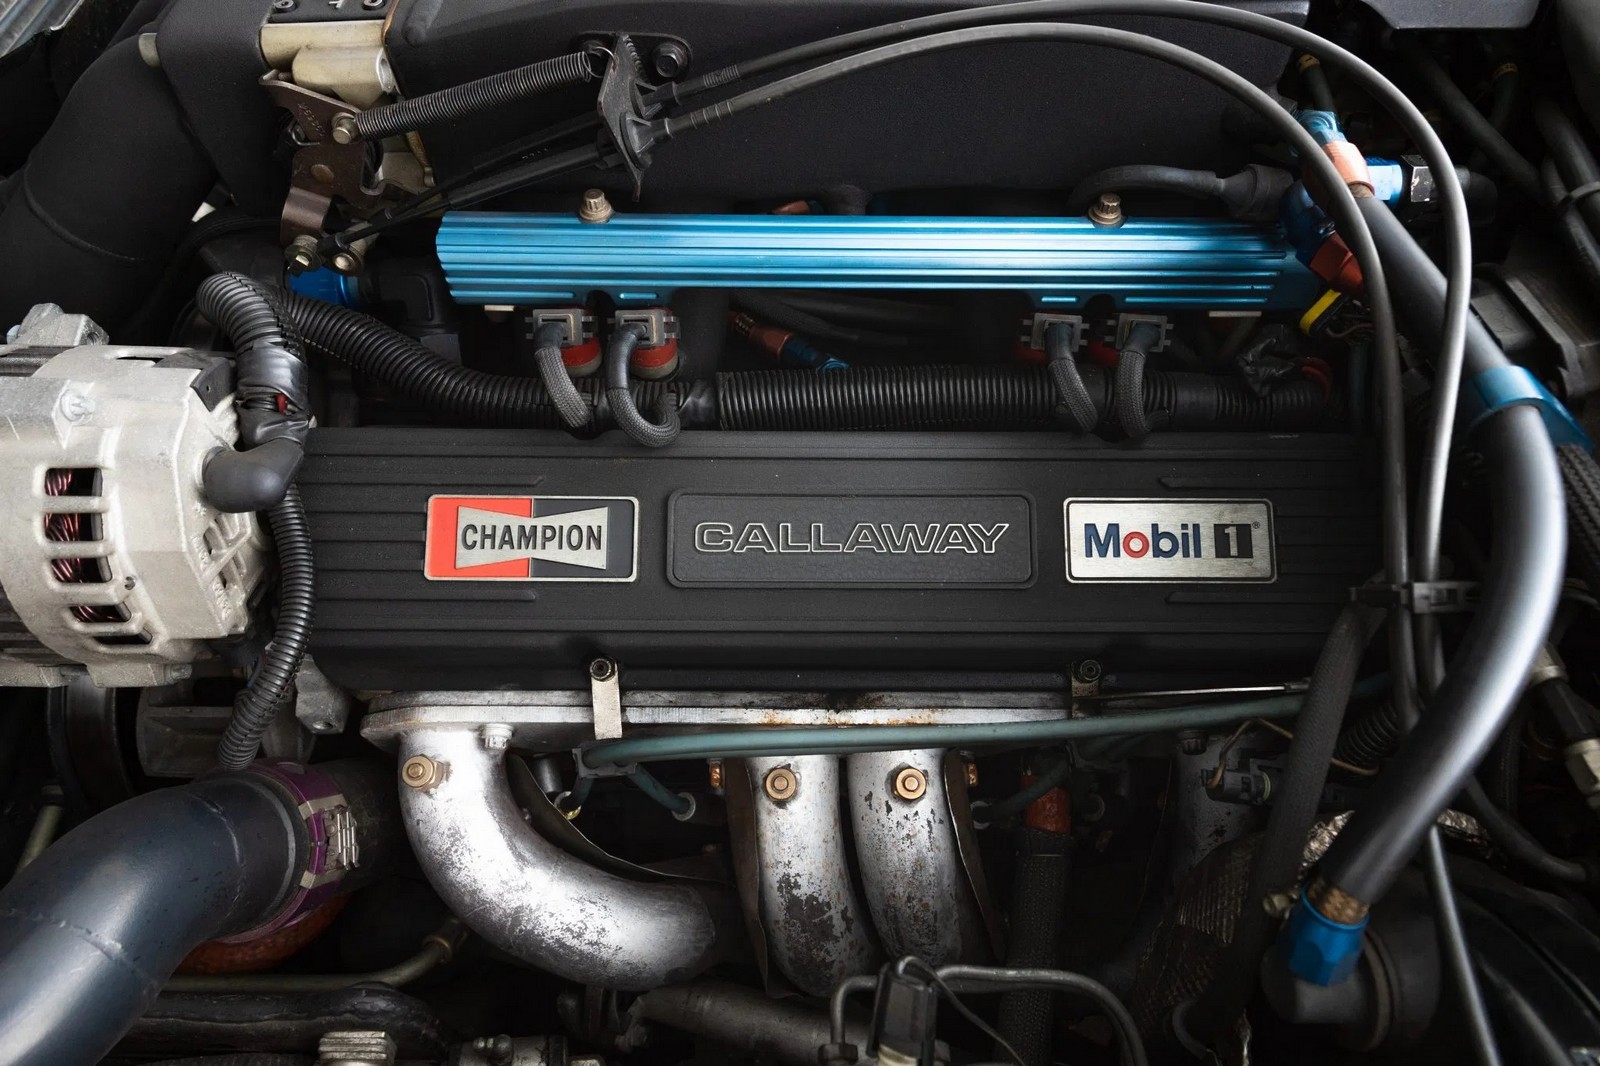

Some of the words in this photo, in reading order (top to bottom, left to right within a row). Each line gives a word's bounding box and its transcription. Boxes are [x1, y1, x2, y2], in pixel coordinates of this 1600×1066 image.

[461, 523, 602, 551] CHAMPION
[695, 522, 1009, 553] CALLAWAY
[1084, 523, 1202, 558] Mobil
[1223, 525, 1240, 557] 1
